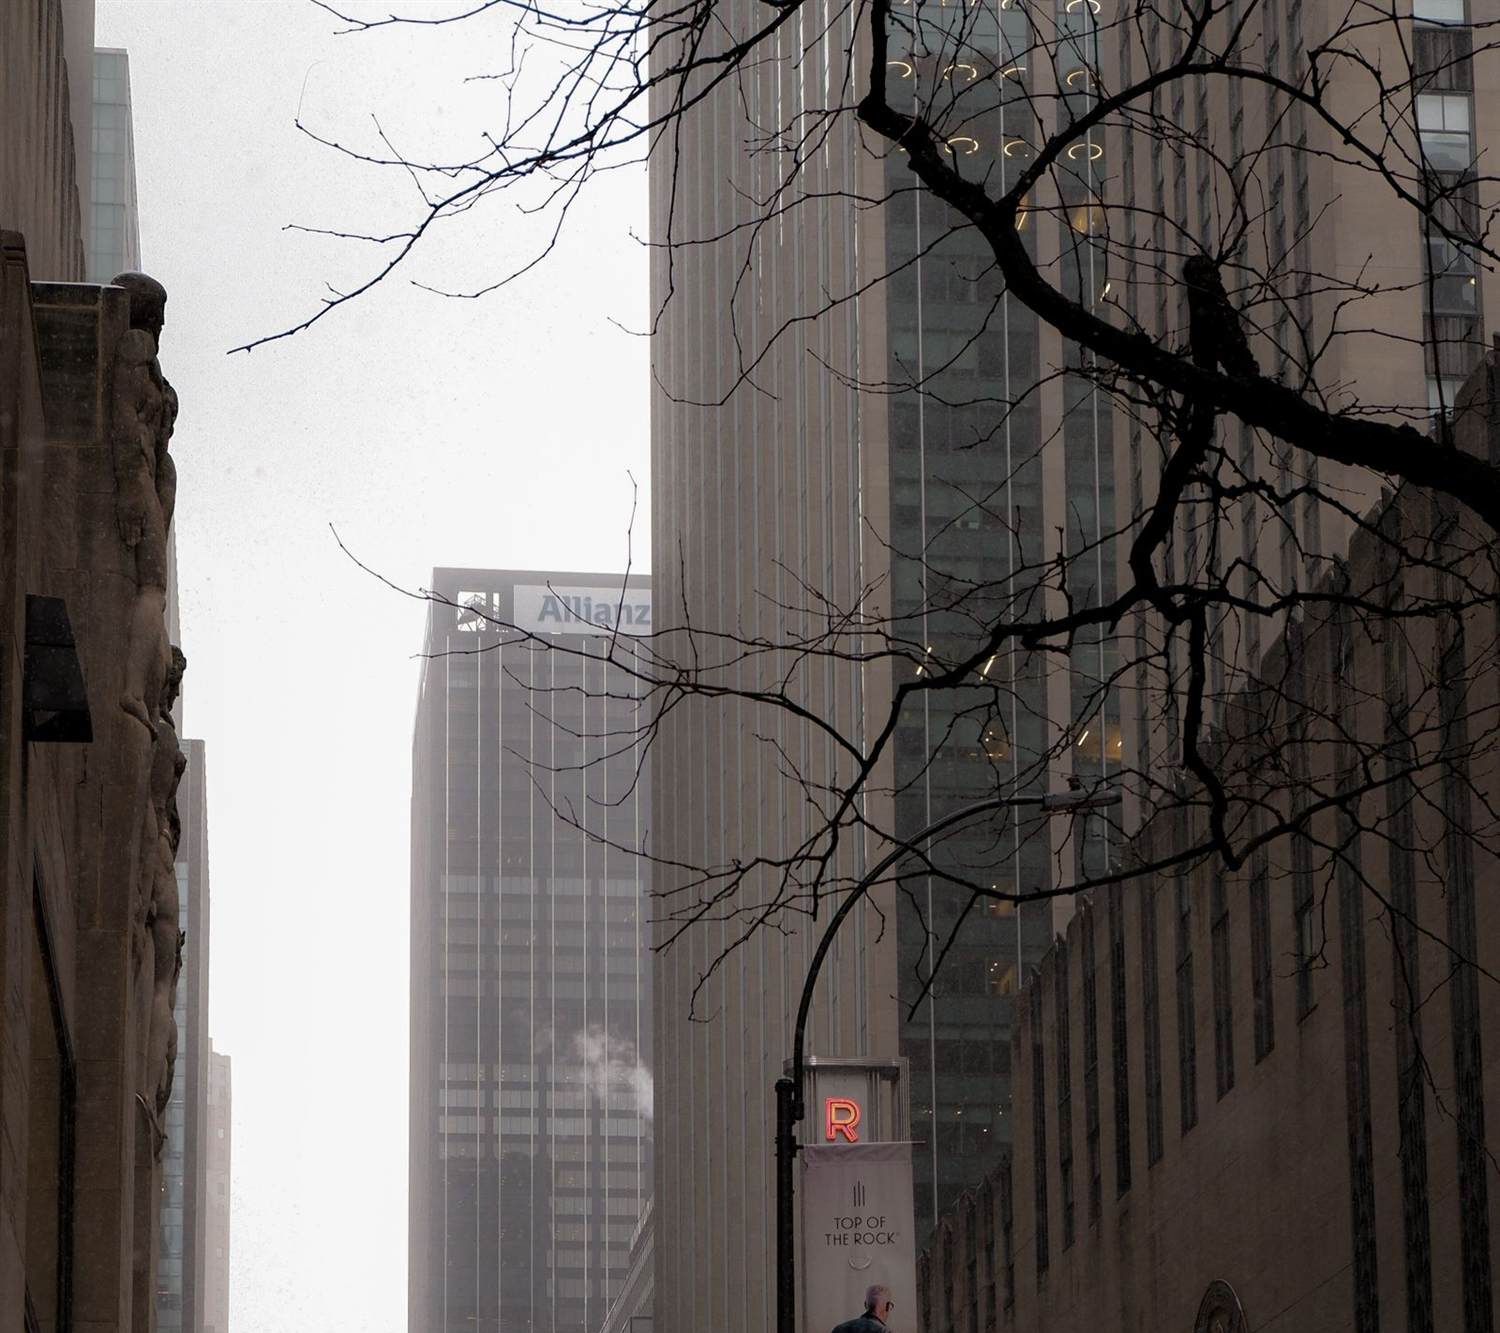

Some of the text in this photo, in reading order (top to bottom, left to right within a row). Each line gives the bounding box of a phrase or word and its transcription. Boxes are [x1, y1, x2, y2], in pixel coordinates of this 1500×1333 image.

[537, 595, 651, 625] Allianz
[825, 1096, 861, 1142] R
[834, 1216, 886, 1230] TOP OF
[825, 1232, 895, 1246] THE ROCK
